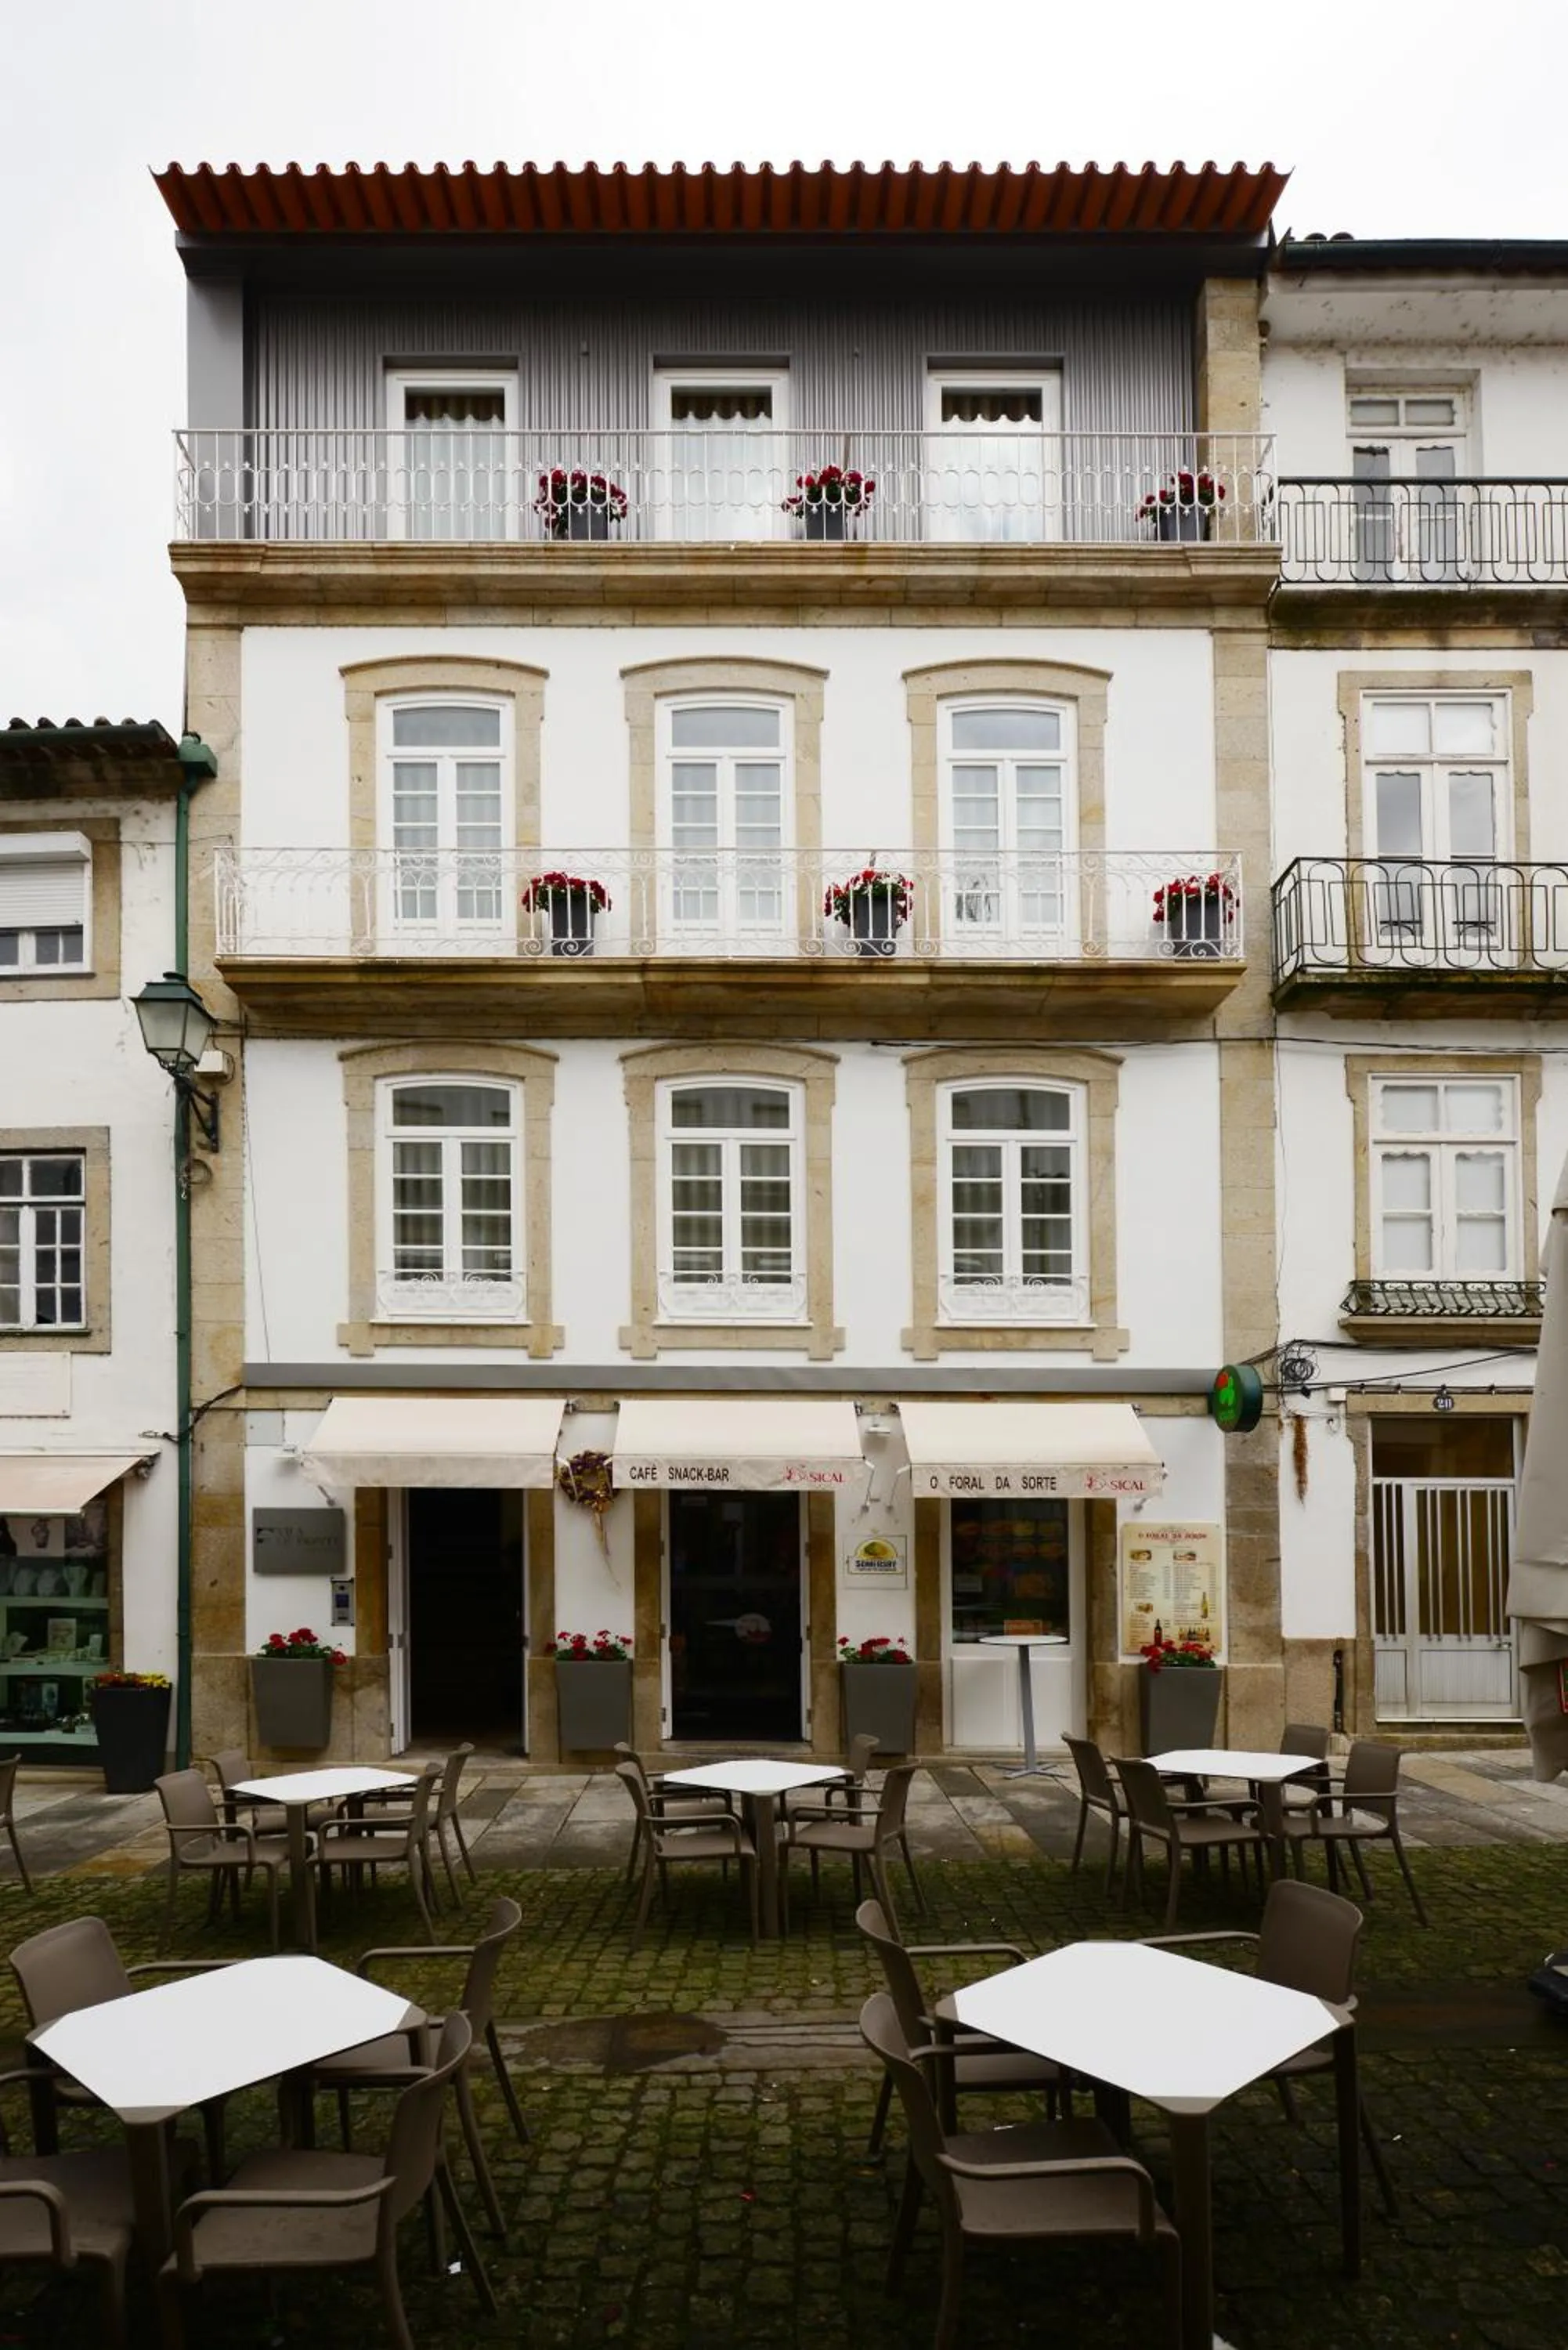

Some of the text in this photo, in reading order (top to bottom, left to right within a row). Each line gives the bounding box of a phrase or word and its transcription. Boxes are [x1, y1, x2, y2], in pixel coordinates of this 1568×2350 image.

[668, 1466, 730, 1482] SNACK-BAR
[808, 1471, 846, 1484] SICAL
[930, 1476, 1057, 1491] O FORAL DA SORTE
[1110, 1479, 1147, 1491] SICAL
